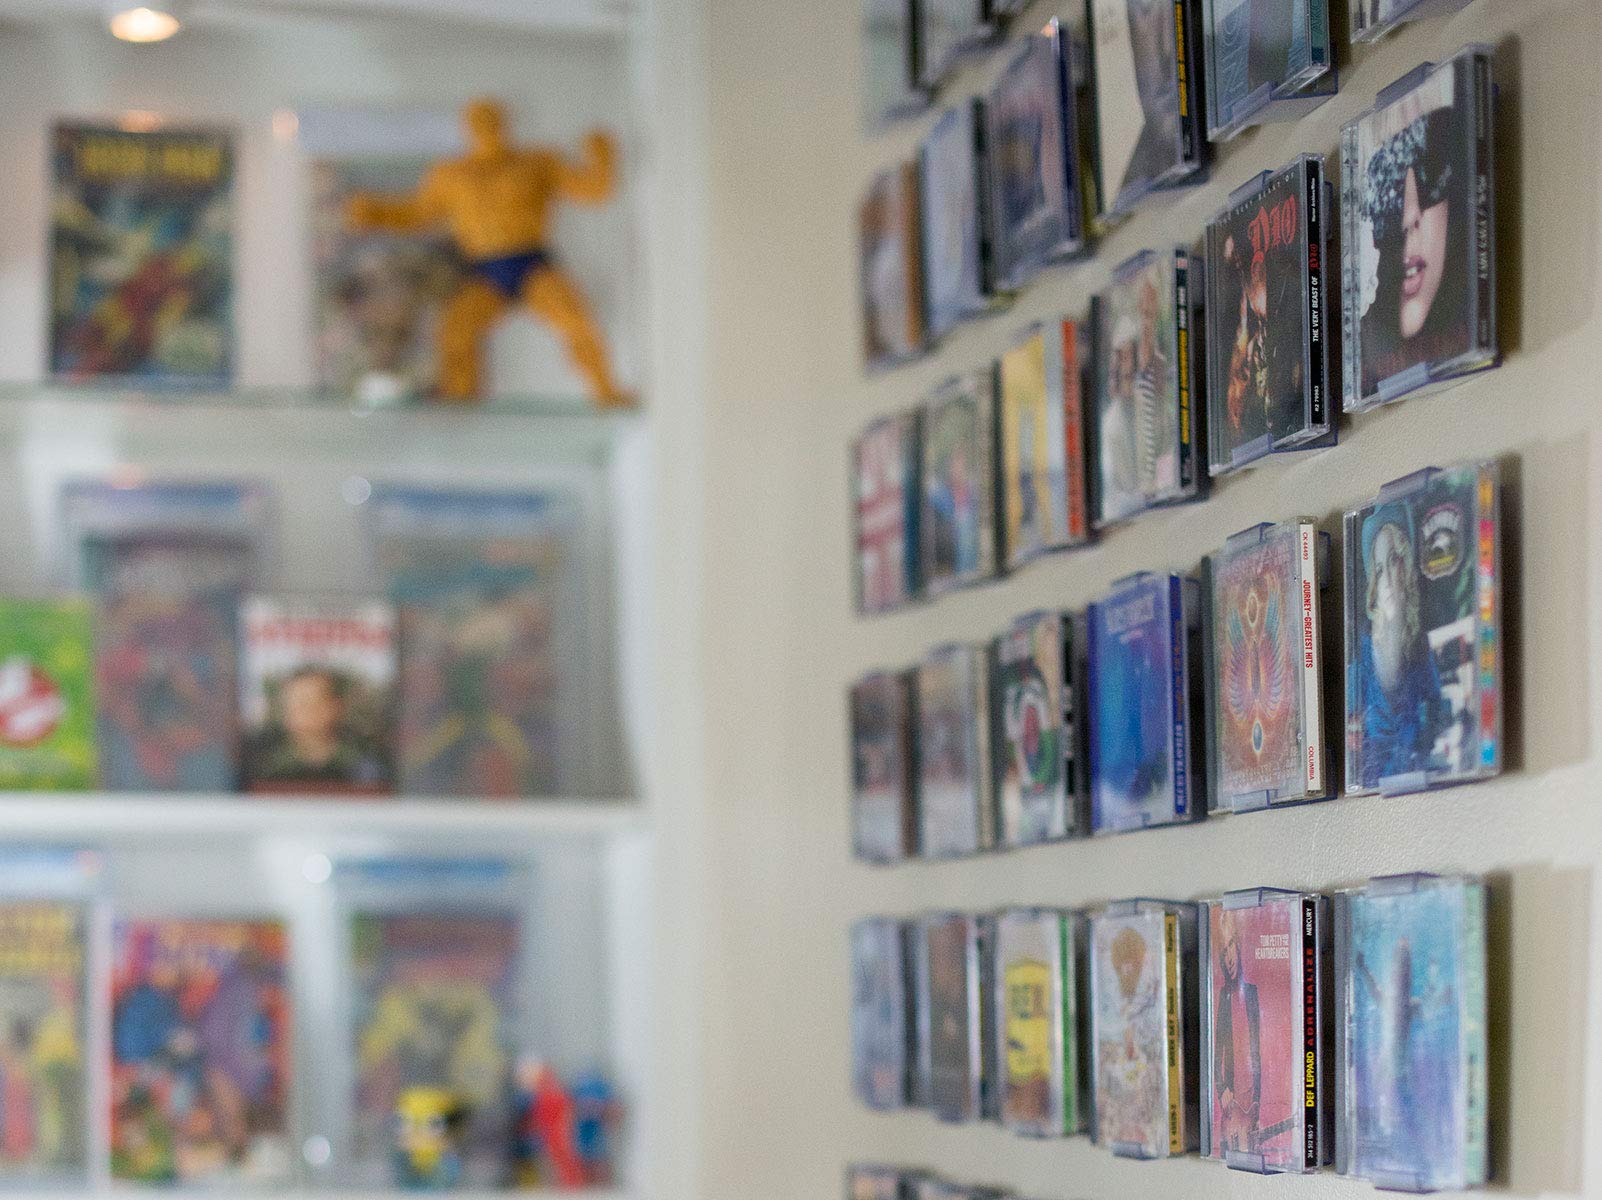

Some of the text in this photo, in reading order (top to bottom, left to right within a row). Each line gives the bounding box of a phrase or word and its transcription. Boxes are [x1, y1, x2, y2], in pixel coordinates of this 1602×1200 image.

[1311, 276, 1318, 286] OF
[1311, 287, 1319, 308] BEAST
[1302, 532, 1309, 541] CK
[1305, 652, 1314, 668] HITS
[1305, 907, 1313, 936] MERCURY
[1306, 948, 1314, 1046] ADRENALIZE
[1304, 1051, 1315, 1108] DEF LEPPARD
